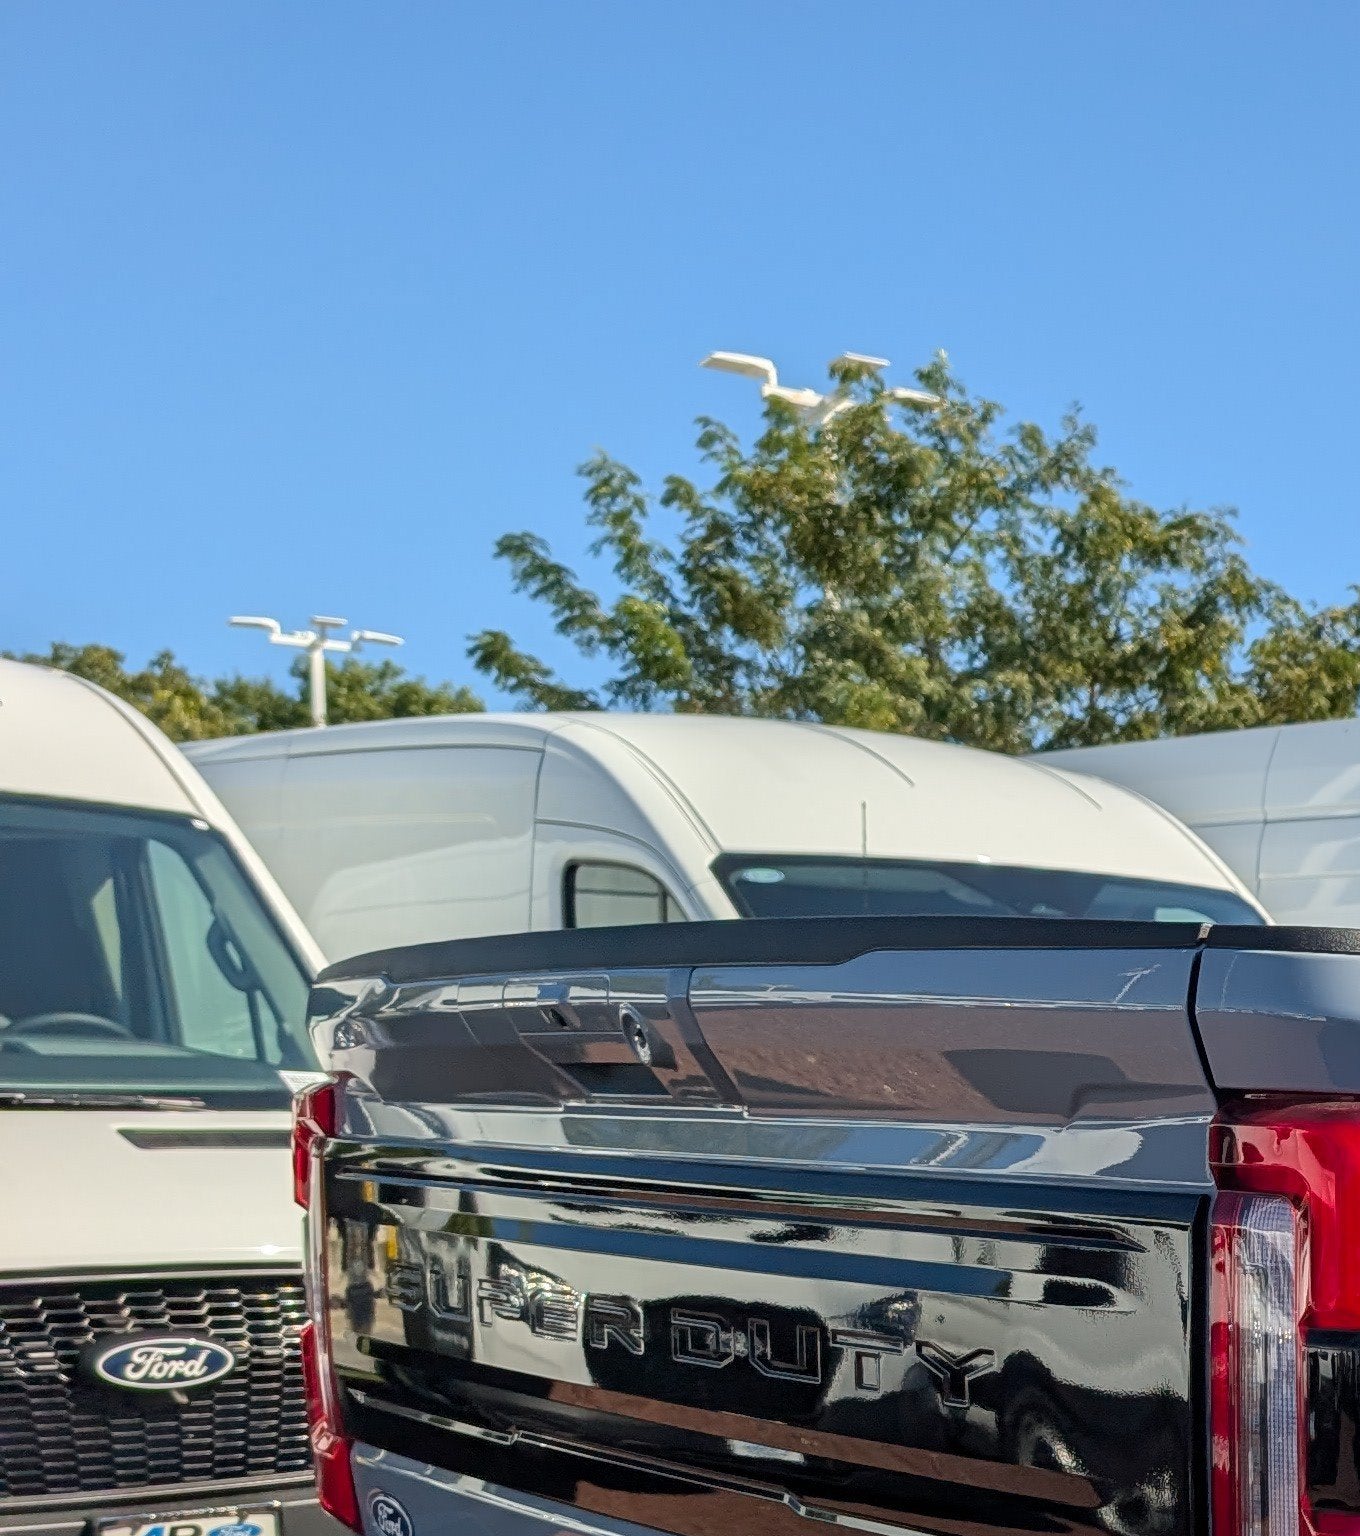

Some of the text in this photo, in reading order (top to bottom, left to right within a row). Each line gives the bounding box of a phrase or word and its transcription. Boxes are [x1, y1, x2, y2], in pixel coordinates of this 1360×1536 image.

[124, 1346, 209, 1380] Ford
[387, 1262, 996, 1408] SUPER DUTY
